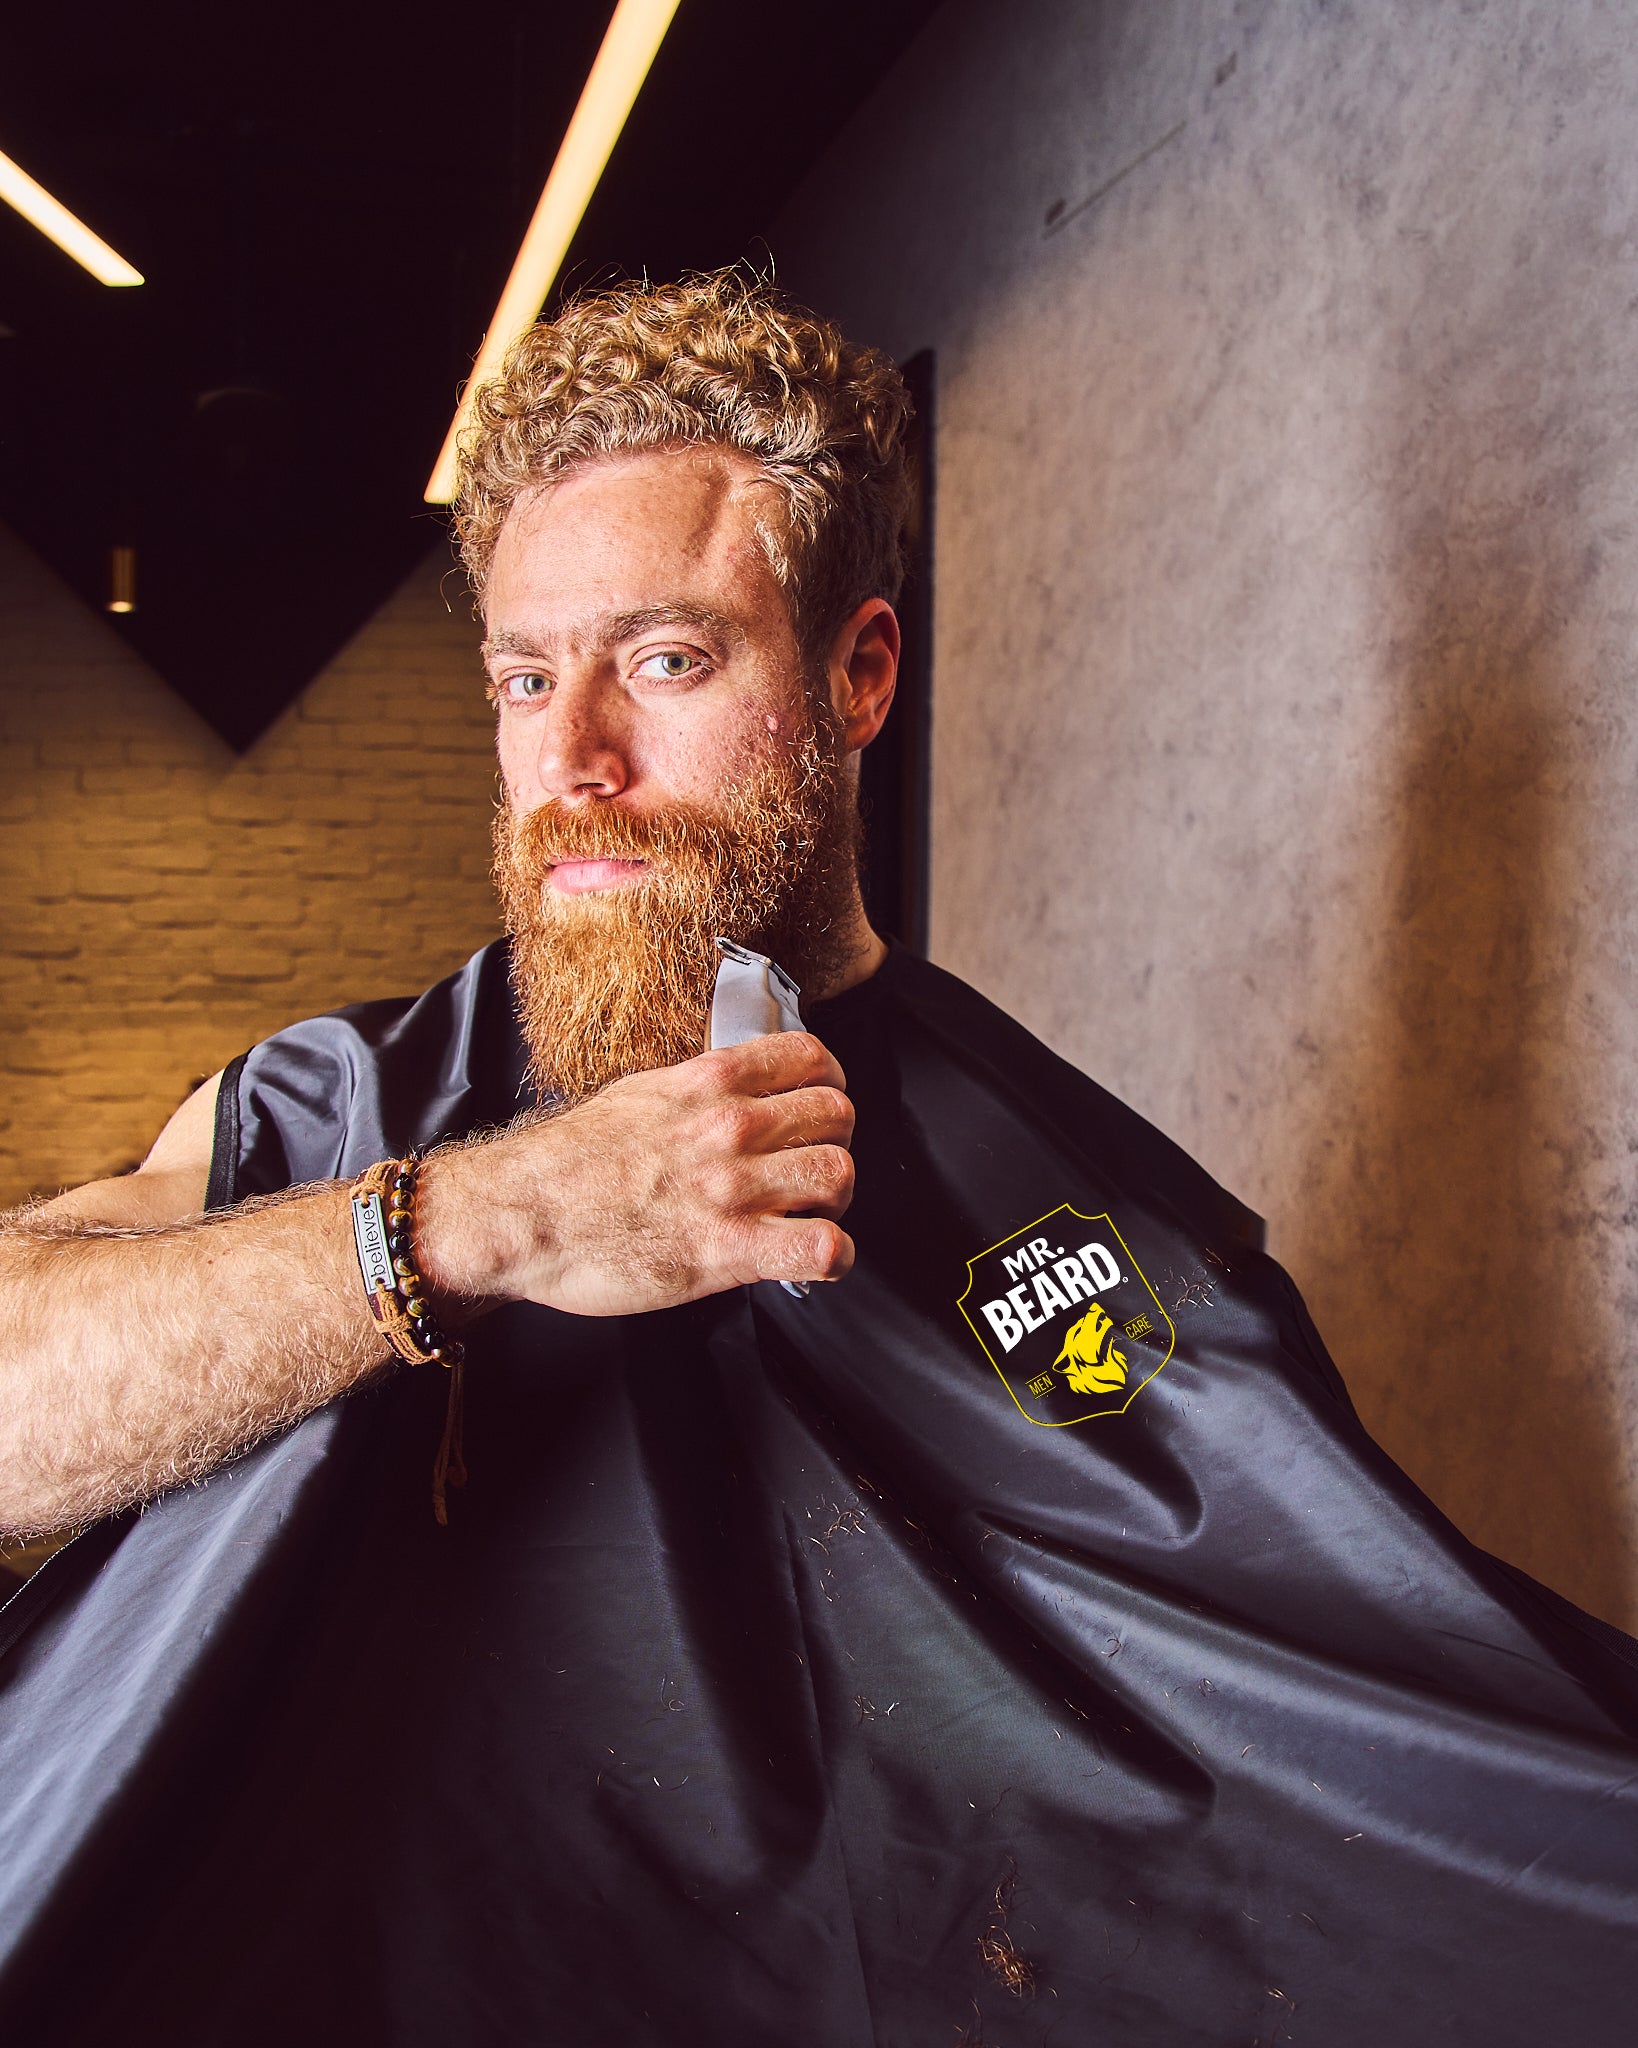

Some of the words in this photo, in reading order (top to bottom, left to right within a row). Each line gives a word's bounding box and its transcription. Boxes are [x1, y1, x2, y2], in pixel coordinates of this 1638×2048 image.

[363, 1209, 386, 1279] believe
[1001, 1237, 1065, 1283] MR.
[1028, 1375, 1054, 1396] MEN
[1125, 1315, 1153, 1339] CARE
